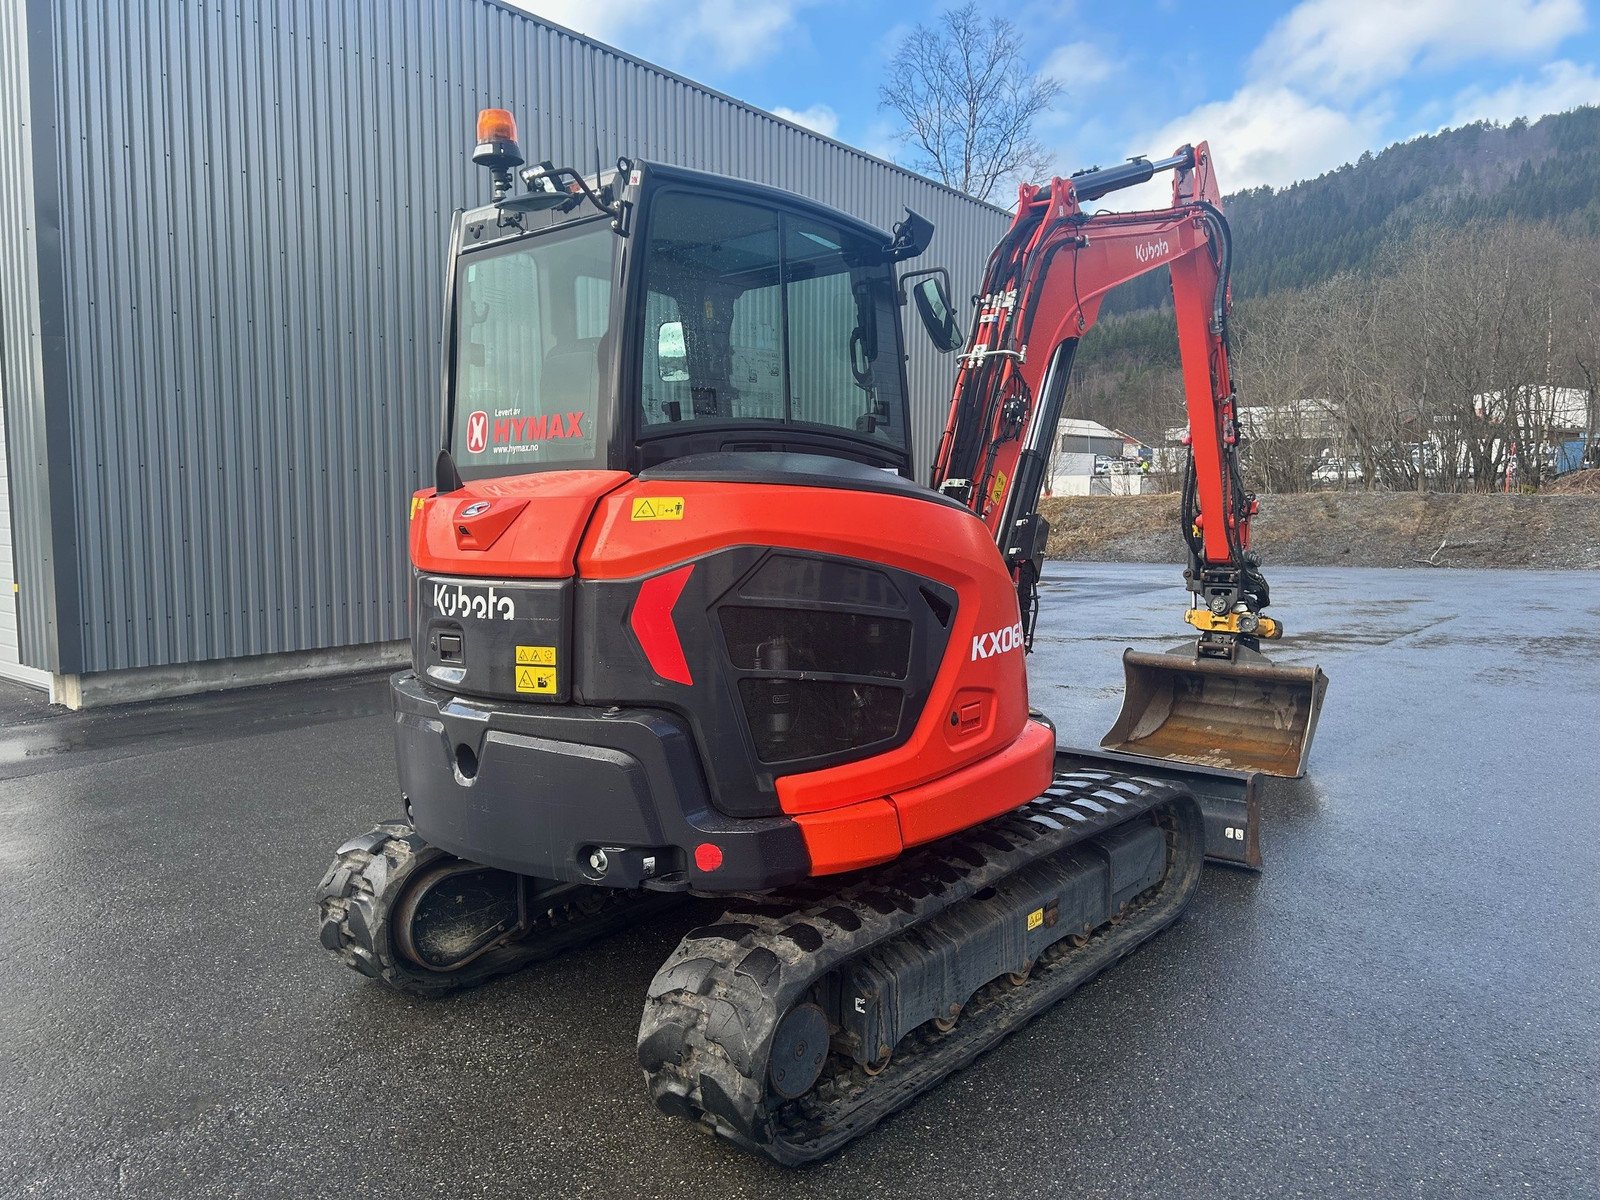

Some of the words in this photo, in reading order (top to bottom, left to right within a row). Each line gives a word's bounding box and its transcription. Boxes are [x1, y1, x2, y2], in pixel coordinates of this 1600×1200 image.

[1135, 238, 1169, 263] Kubota
[494, 408, 512, 417] Levert
[512, 407, 521, 415] av
[493, 412, 583, 443] HYMAX
[493, 445, 539, 454] www.hymax.no
[433, 583, 515, 621] Kubota
